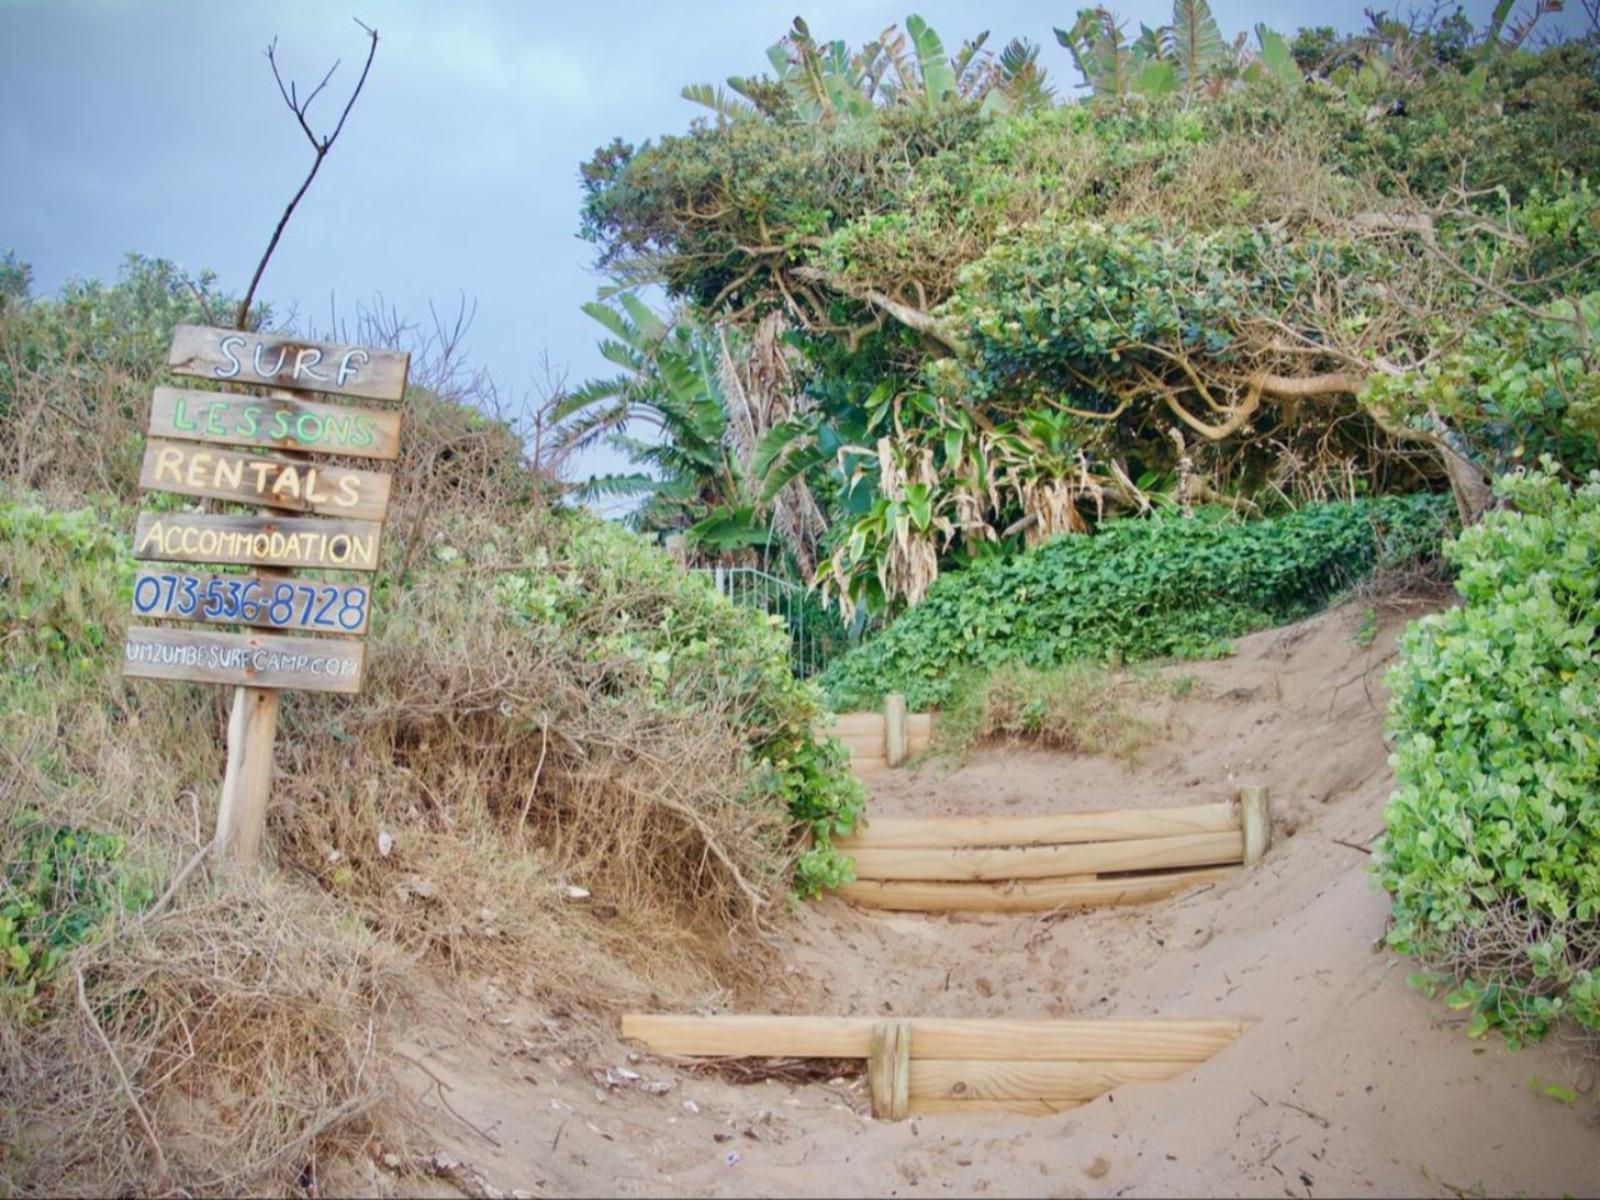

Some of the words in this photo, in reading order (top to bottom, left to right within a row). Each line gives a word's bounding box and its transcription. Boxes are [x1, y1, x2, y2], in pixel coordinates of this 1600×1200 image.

[214, 335, 370, 386] SURF
[173, 398, 377, 446] LESSONS
[155, 448, 361, 507] RENTALS
[138, 520, 374, 564] ACCOMMODATION
[133, 575, 368, 631] 073-536-8728
